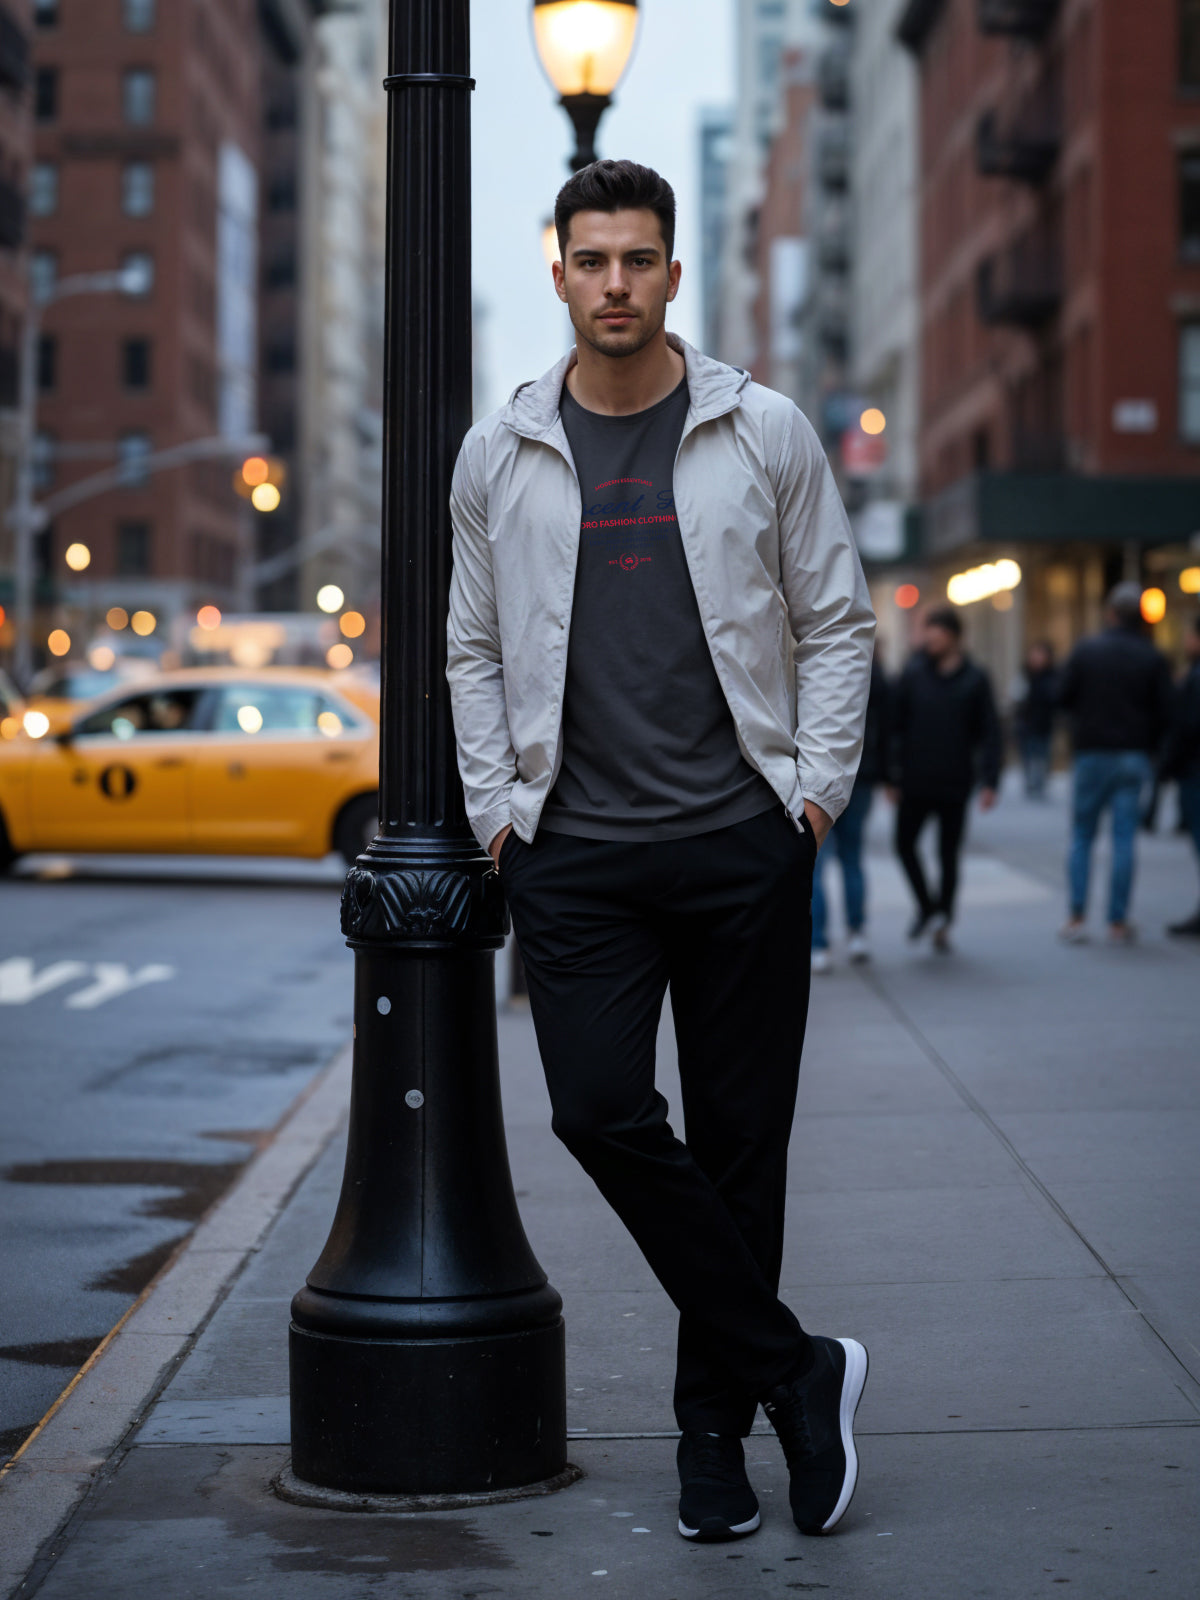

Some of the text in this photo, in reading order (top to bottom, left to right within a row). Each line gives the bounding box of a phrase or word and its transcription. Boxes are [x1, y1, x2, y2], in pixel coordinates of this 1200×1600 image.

[594, 477, 653, 491] MODERN ESSENTIALS
[599, 517, 636, 528] FASHION
[638, 515, 677, 525] CLOTHIN
